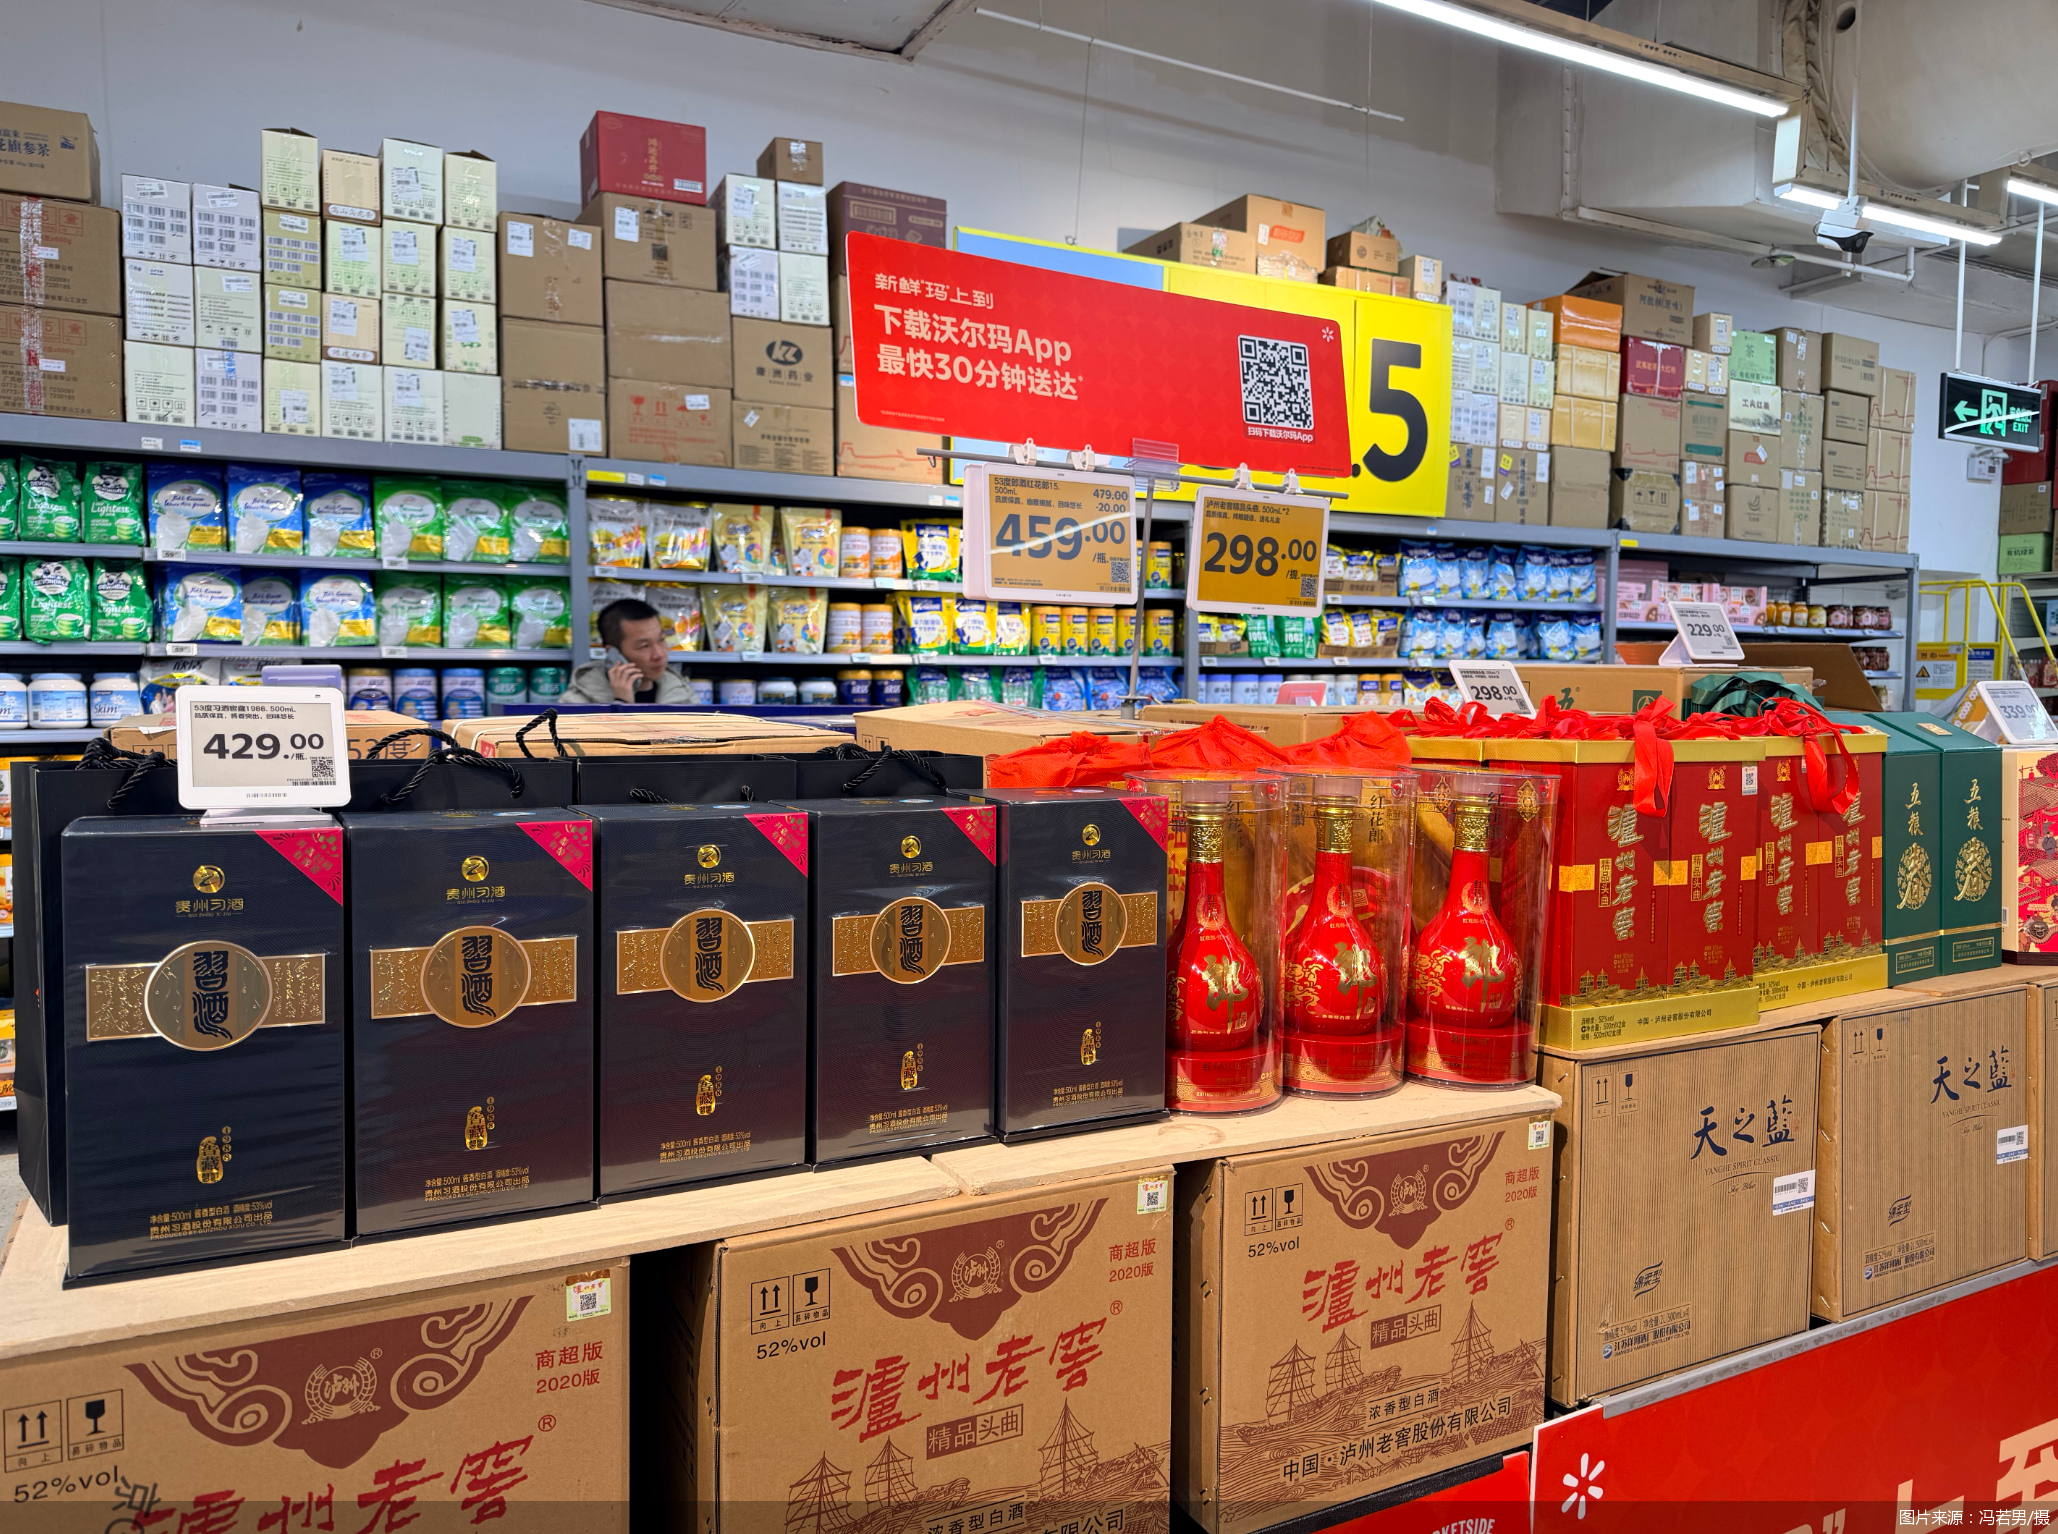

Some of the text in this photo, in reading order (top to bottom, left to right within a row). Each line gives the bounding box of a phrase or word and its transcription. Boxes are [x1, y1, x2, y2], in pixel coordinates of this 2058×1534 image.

[874, 304, 1072, 366] 下载沃尔玛App
[1248, 426, 1314, 443] 扫码下载沃尔玛App
[2012, 421, 2030, 434] EXIT
[1093, 489, 1128, 500] 479.00
[1096, 502, 1126, 513] -20.00
[996, 513, 1126, 560] 459.00
[1204, 532, 1317, 577] 298.00
[93, 702, 119, 716] Skim
[1368, 794, 1385, 844] 红花郎
[1072, 850, 1110, 861] 贵州习酒
[1766, 842, 1775, 886] 精品头曲
[1835, 835, 1844, 878] 精品头曲
[684, 872, 735, 886] 贵州习酒
[890, 862, 934, 874] 贵州习酒
[1692, 854, 1703, 901] 精品头曲
[446, 886, 506, 900] 贵州习酒
[1600, 858, 1612, 906] 精品头曲
[174, 898, 244, 913] 贵州习酒
[1334, 942, 1378, 1020] 郎
[1462, 936, 1504, 1014] 郎
[1203, 955, 1248, 1034] 郎
[660, 1140, 751, 1160] 贵州习酒股份有限公司出品
[1504, 1166, 1540, 1186] 商超版
[1704, 1154, 1781, 1176] YANGHE SPIRIT CLASSIC
[425, 1176, 530, 1198] 贵州习酒股份有限公司出品
[462, 1170, 493, 1183] 酱香型白酒
[1504, 1186, 1538, 1204] 2020版
[194, 1205, 230, 1219] 酱香型白酒
[150, 1211, 272, 1236] 贵州习酒股份有限公司出品
[1250, 1224, 1268, 1234] 向上
[1108, 1237, 1156, 1264] 商超版
[1248, 1236, 1300, 1259] 52%vol
[1108, 1262, 1154, 1283] 2020版
[758, 1318, 782, 1330] 向上
[796, 1308, 829, 1324] 易碎物品
[1372, 1308, 1439, 1344] 精品头曲
[536, 1341, 604, 1370] 商超版
[756, 1330, 826, 1360] 52%vol
[536, 1368, 600, 1394] 2020版
[1368, 1388, 1440, 1421] 浓香型白酒
[928, 1408, 1020, 1452] 精品头曲
[1282, 1396, 1511, 1483] 中国·泸州老窖股份有限公司
[72, 1438, 122, 1456] 易碎物品
[18, 1452, 50, 1468] 向上
[14, 1465, 118, 1504] 52%vol
[928, 1502, 1025, 1534] 浓香型白酒
